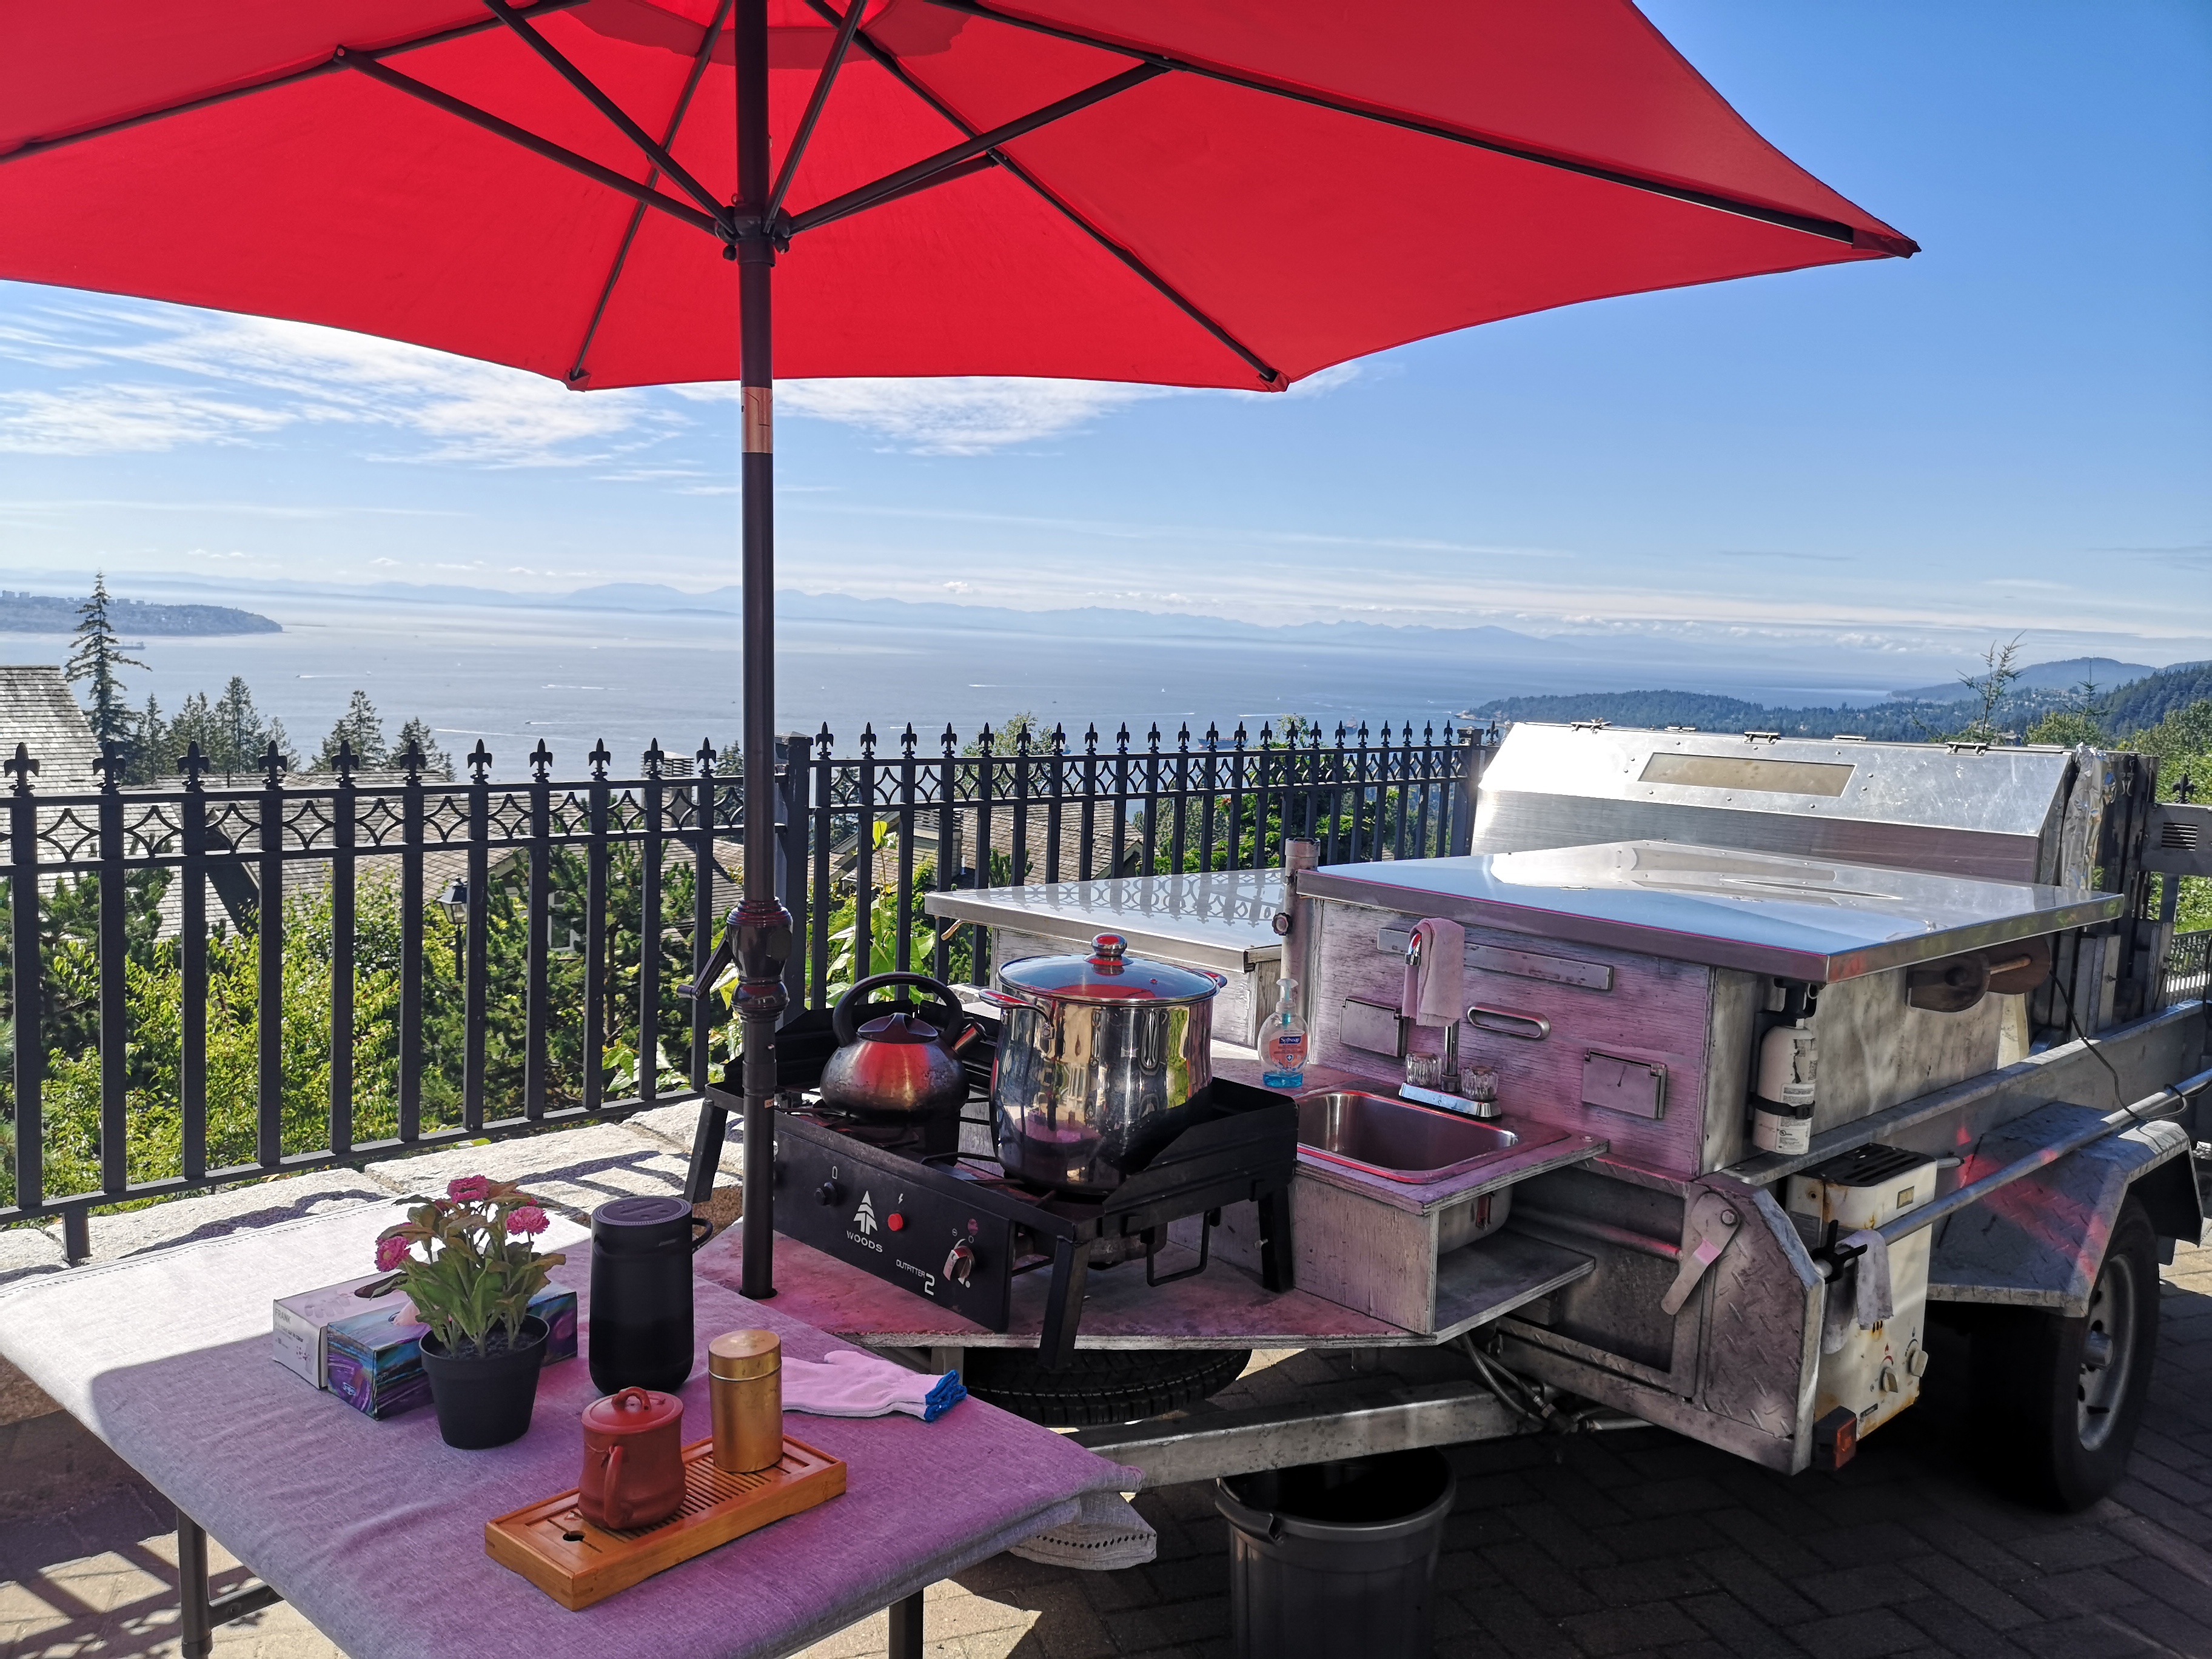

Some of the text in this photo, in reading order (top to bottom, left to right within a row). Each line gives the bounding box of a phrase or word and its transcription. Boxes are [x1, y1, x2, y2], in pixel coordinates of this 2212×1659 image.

[846, 1230, 883, 1253] WOODS
[896, 1259, 935, 1296] OUTFITTER 2
[275, 1307, 291, 1324] FRANK
